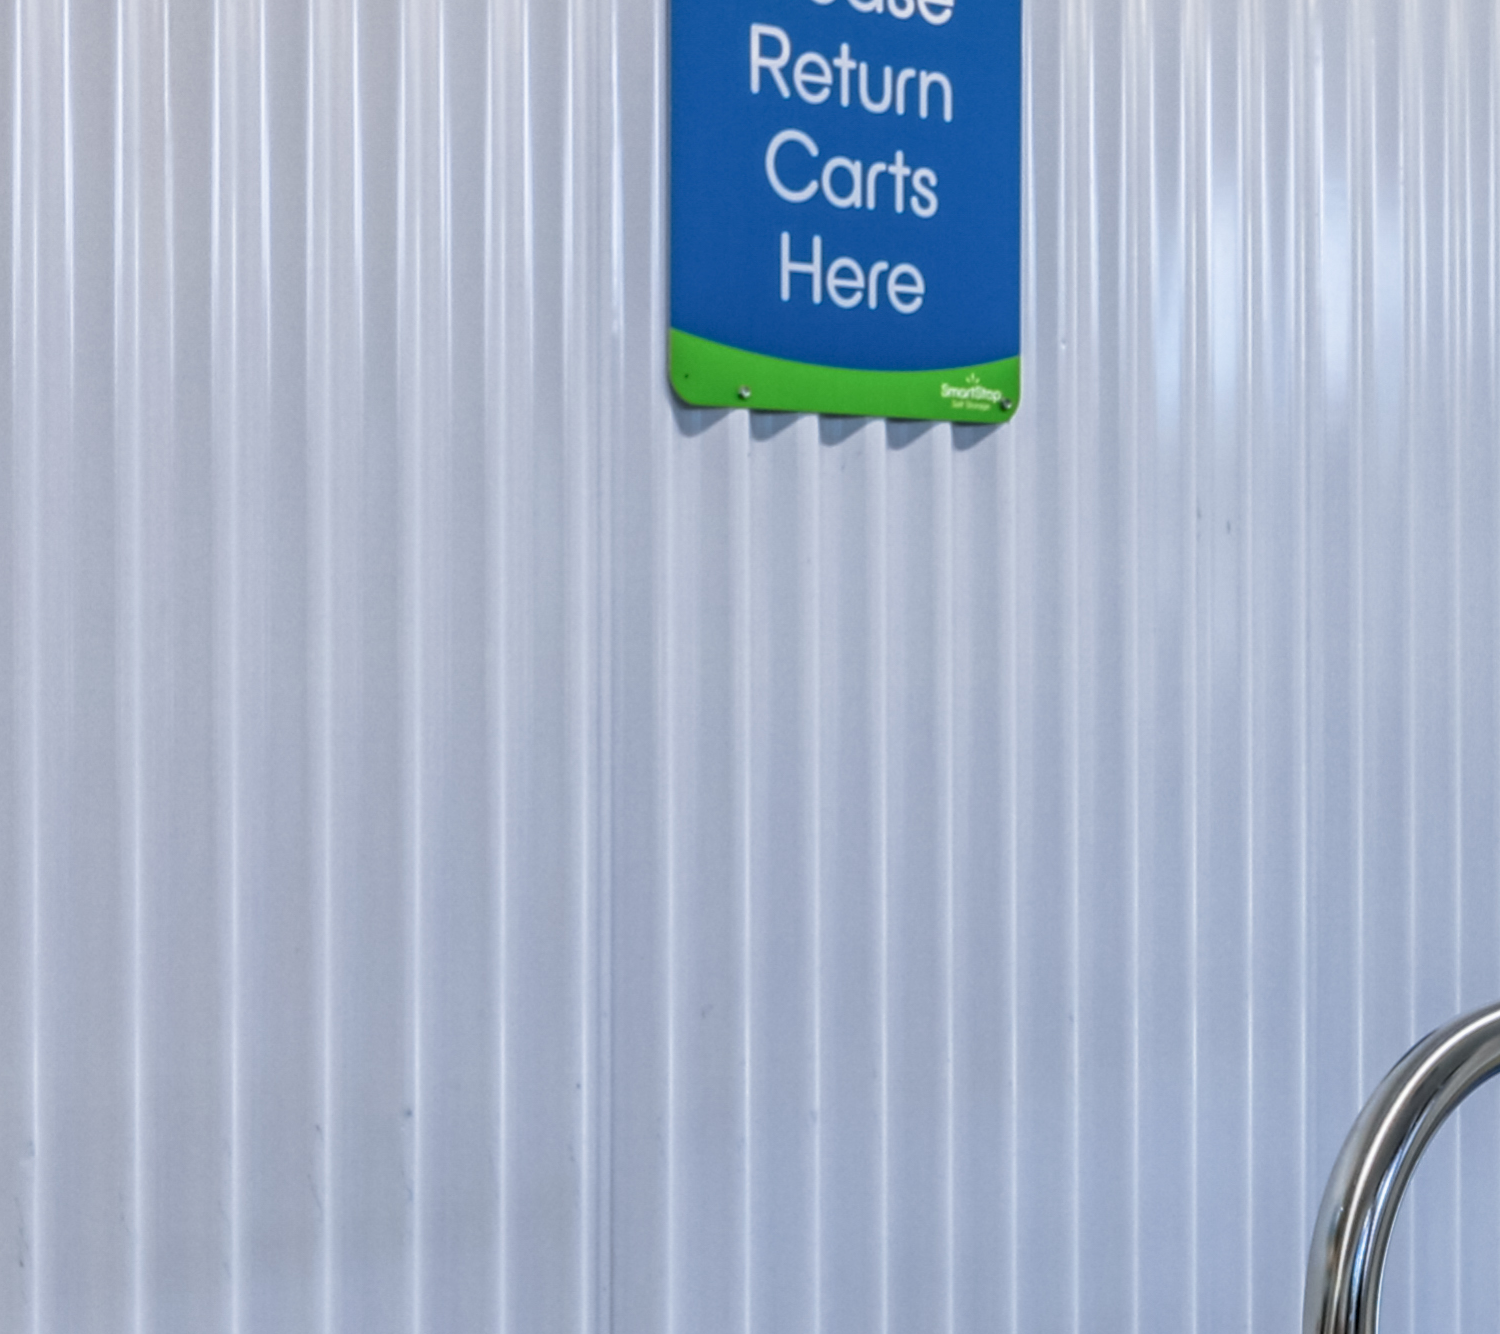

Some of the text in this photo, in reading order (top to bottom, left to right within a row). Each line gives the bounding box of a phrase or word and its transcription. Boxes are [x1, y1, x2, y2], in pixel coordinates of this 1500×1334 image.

[749, 22, 953, 123] Return
[765, 129, 939, 219] Carts
[780, 230, 926, 315] Here
